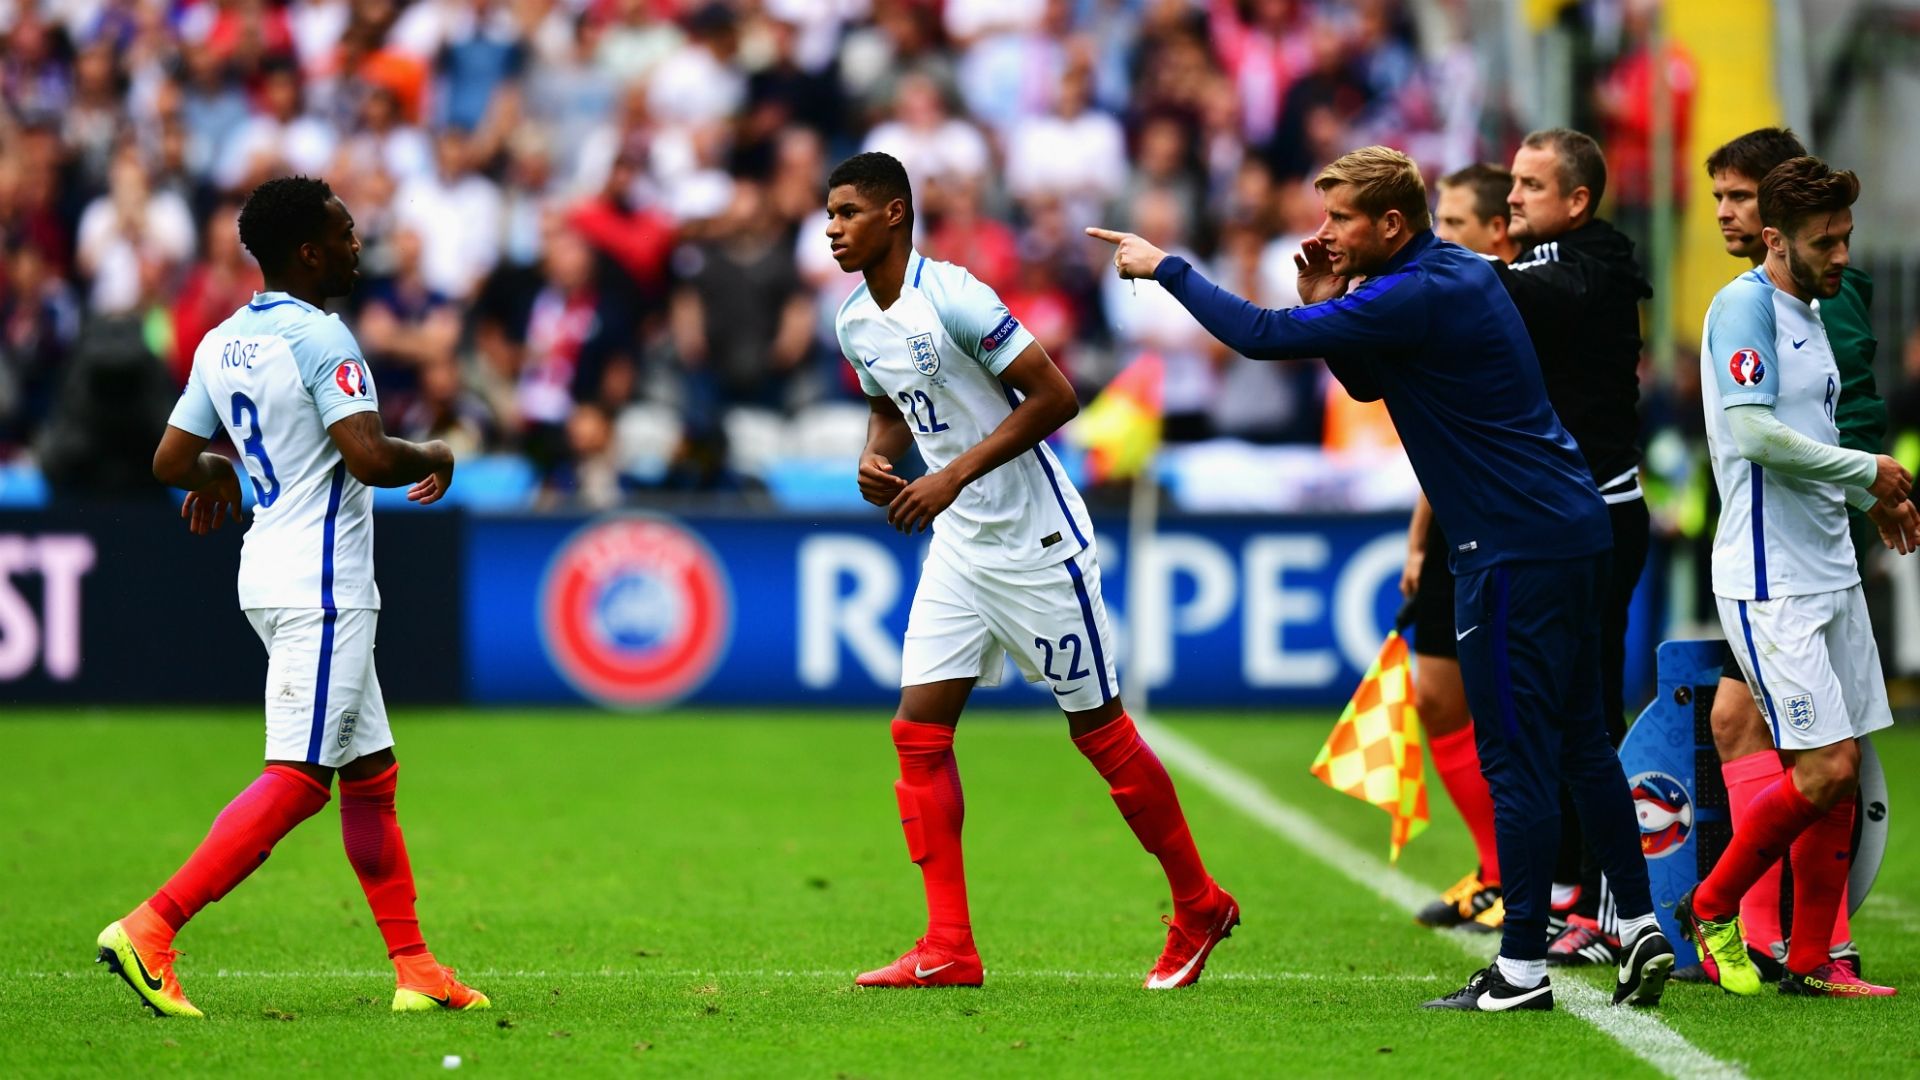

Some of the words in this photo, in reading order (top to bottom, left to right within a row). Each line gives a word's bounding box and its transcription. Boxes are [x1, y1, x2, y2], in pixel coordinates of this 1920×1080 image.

[993, 317, 1016, 342] RESPECT
[898, 390, 949, 433] 22
[231, 391, 280, 508] 3
[798, 533, 1412, 689] RPEC
[1035, 633, 1090, 681] 22
